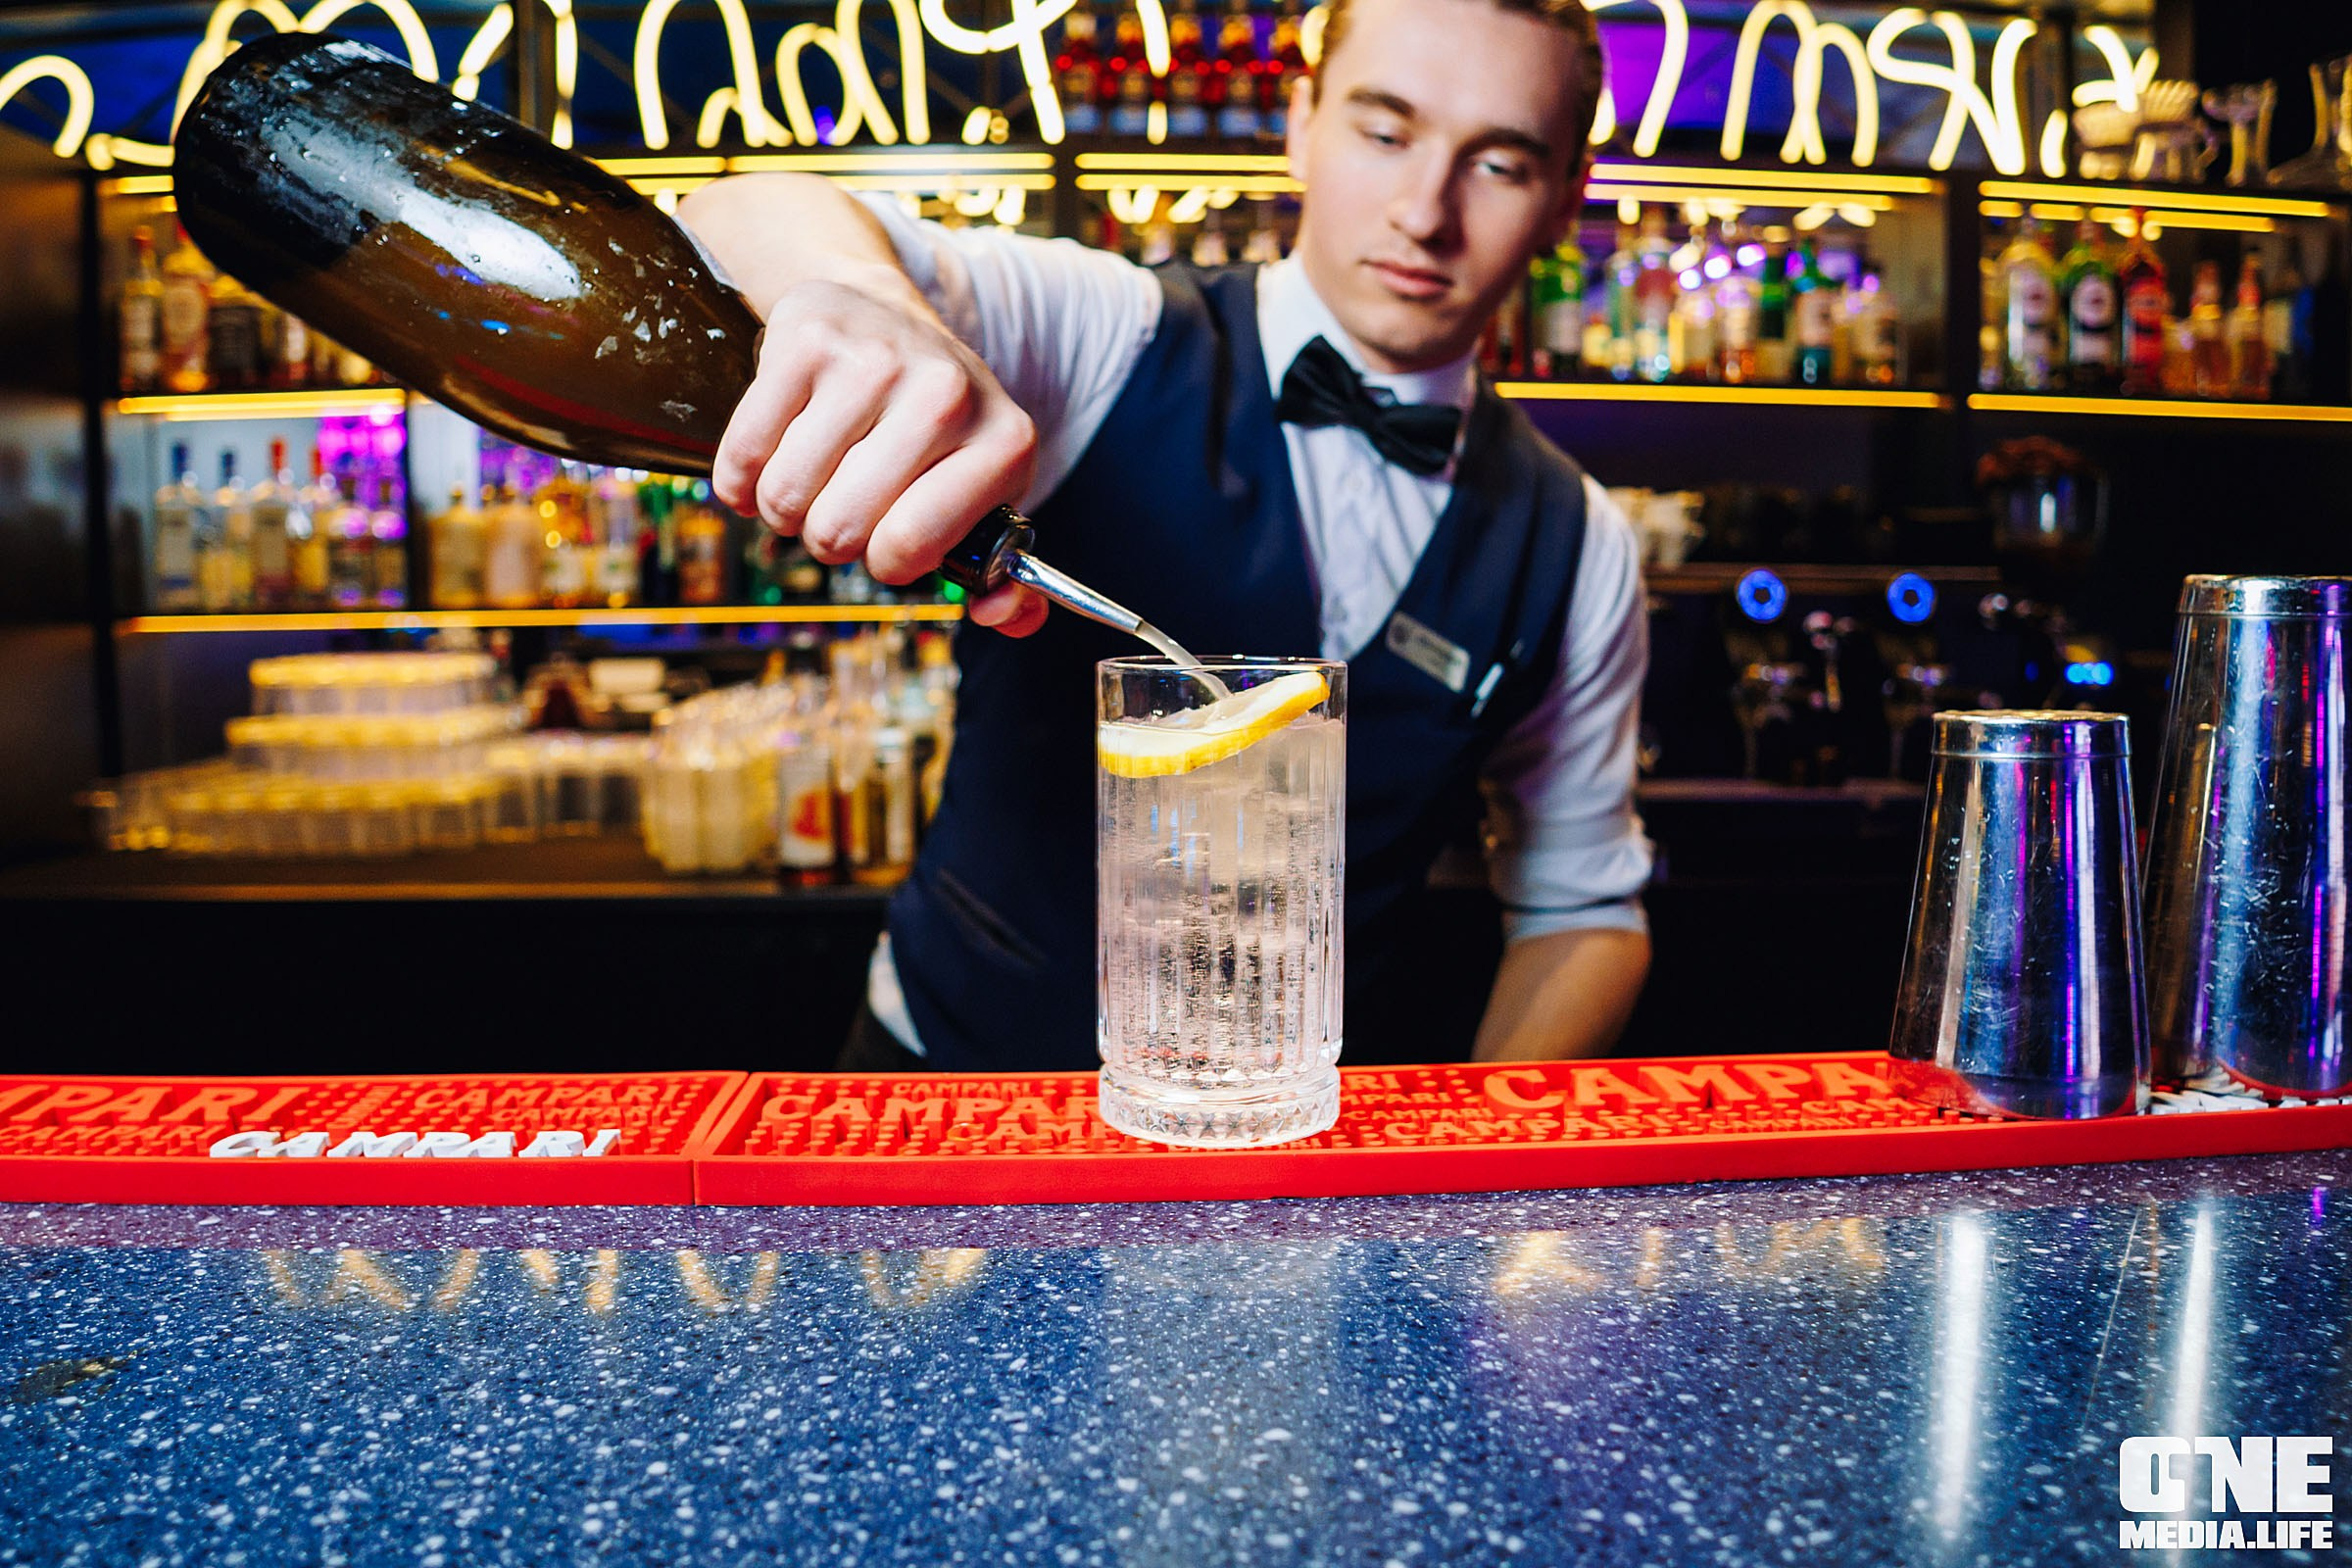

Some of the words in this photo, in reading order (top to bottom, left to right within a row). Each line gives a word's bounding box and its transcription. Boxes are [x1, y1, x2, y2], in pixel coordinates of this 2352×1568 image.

[893, 1081, 1031, 1095] CAMPARI
[1342, 1073, 1401, 1091] RI
[1483, 1062, 1892, 1108] CAMPA
[414, 1085, 681, 1109] CAMPARI
[1801, 1097, 1934, 1114] CAM
[490, 1104, 670, 1122] CAMPARI
[1346, 1107, 1495, 1121] CAMPARI
[1384, 1114, 1675, 1140] CAMPARI
[209, 1129, 621, 1158] CAMPARI
